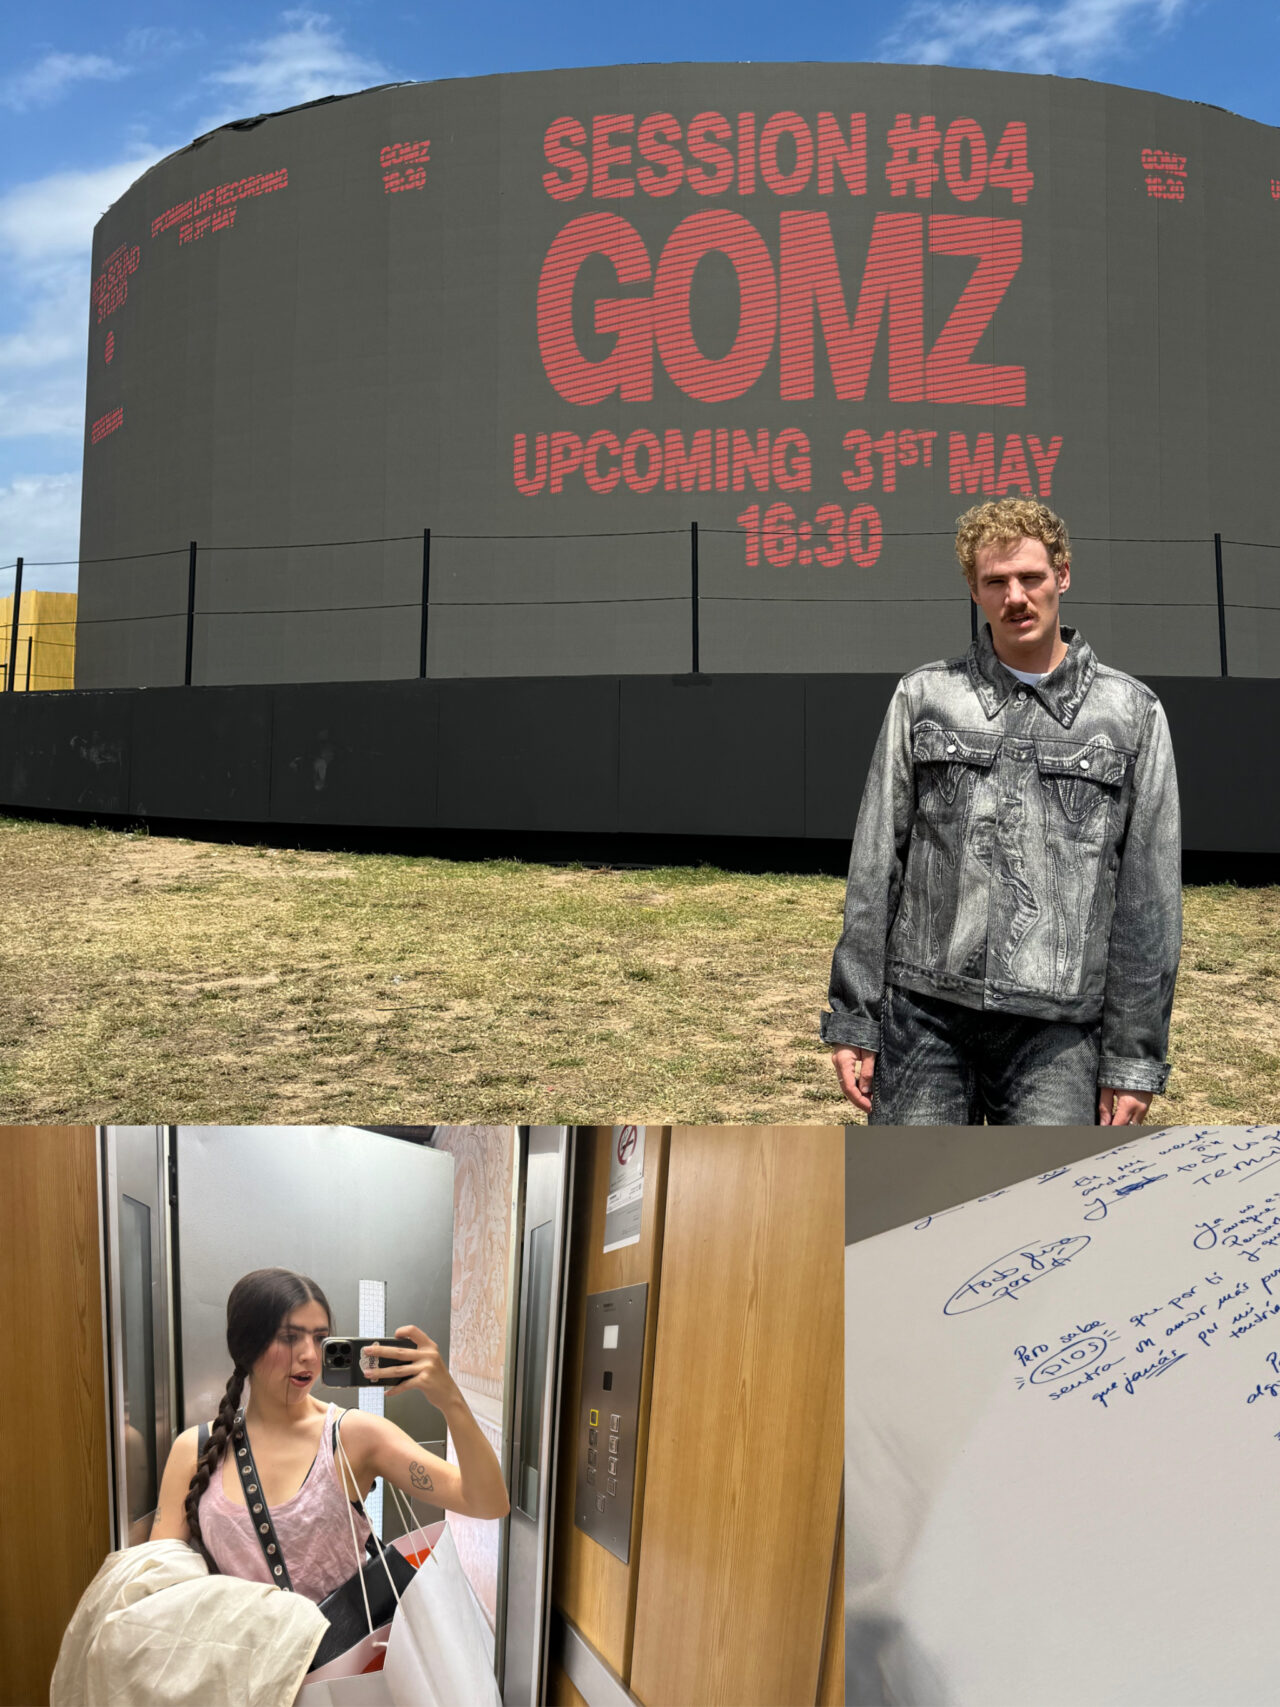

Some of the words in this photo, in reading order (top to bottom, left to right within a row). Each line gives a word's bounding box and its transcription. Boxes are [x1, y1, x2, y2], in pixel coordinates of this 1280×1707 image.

[380, 140, 431, 168] GOMZ
[383, 166, 427, 195] 16:30
[542, 110, 867, 201] SESSION
[885, 113, 1035, 204] #04
[1141, 148, 1188, 178] GOMZ
[151, 199, 193, 239] UPCOMING
[193, 188, 214, 217] LIVE
[215, 168, 288, 206] RECORDING
[1145, 174, 1185, 204] 16:30
[179, 221, 193, 247] FRI
[212, 204, 238, 233] MAY
[536, 208, 1028, 407] GOMZ
[513, 428, 812, 496] UPCOMING
[841, 428, 938, 493] 31ST
[948, 430, 1063, 497] MAY
[736, 502, 884, 568] 16:30
[992, 1273, 1032, 1301] por
[1165, 1304, 1208, 1337] amor
[1217, 1281, 1250, 1310] más
[1014, 1343, 1049, 1367] Pero
[1059, 1320, 1107, 1344] sabe
[1129, 1306, 1164, 1328] que
[1167, 1285, 1198, 1310] por
[1091, 1381, 1119, 1408] que
[1124, 1349, 1178, 1395] jamás
[1197, 1322, 1219, 1347] por
